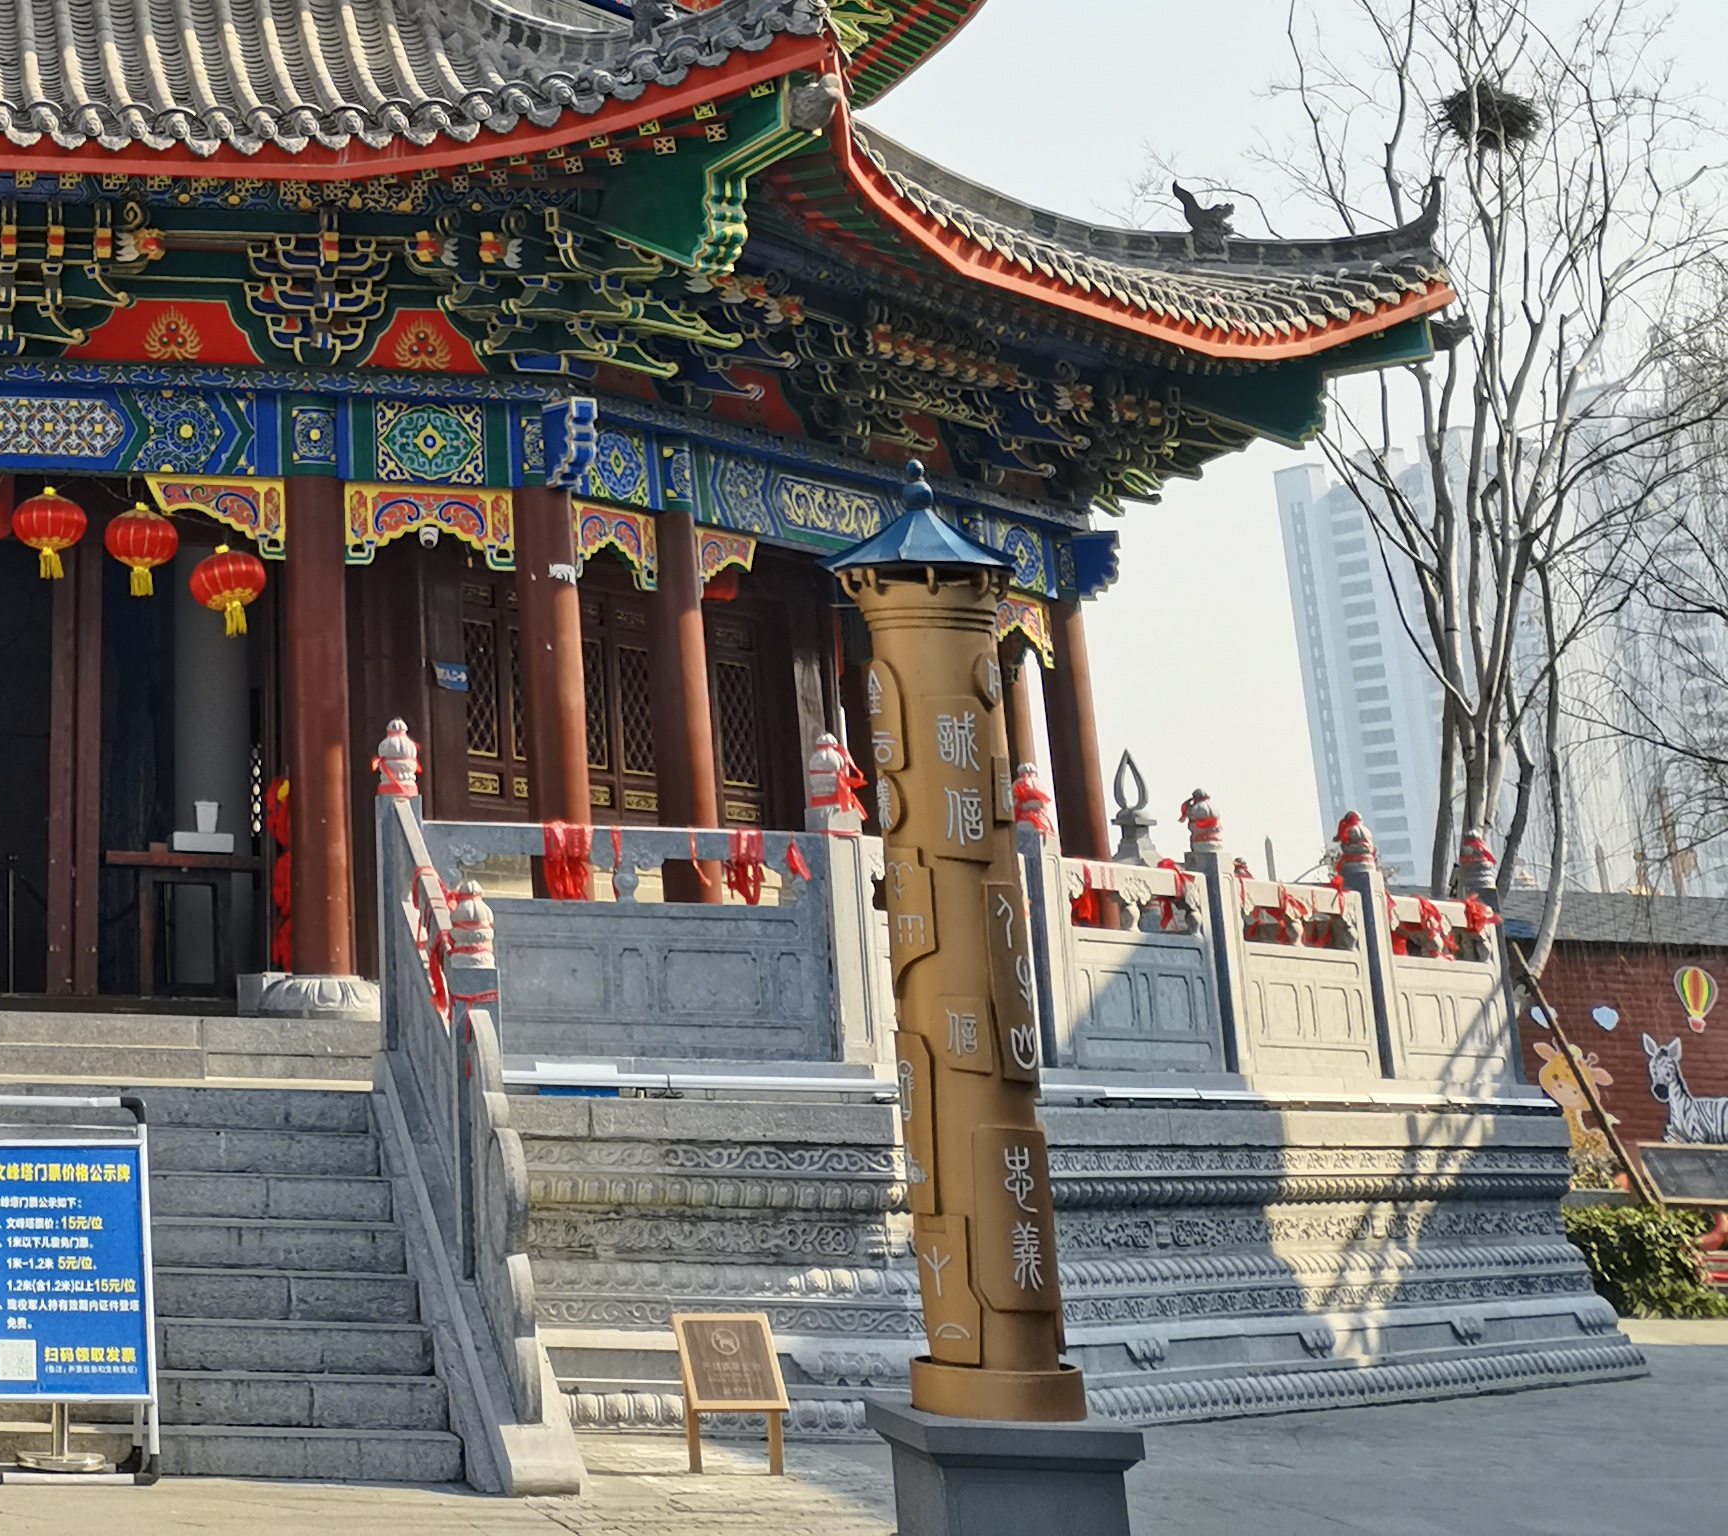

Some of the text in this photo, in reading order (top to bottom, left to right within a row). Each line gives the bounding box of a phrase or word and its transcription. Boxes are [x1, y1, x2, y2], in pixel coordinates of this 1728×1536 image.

[44, 1346, 137, 1363] 扫码领取发票
